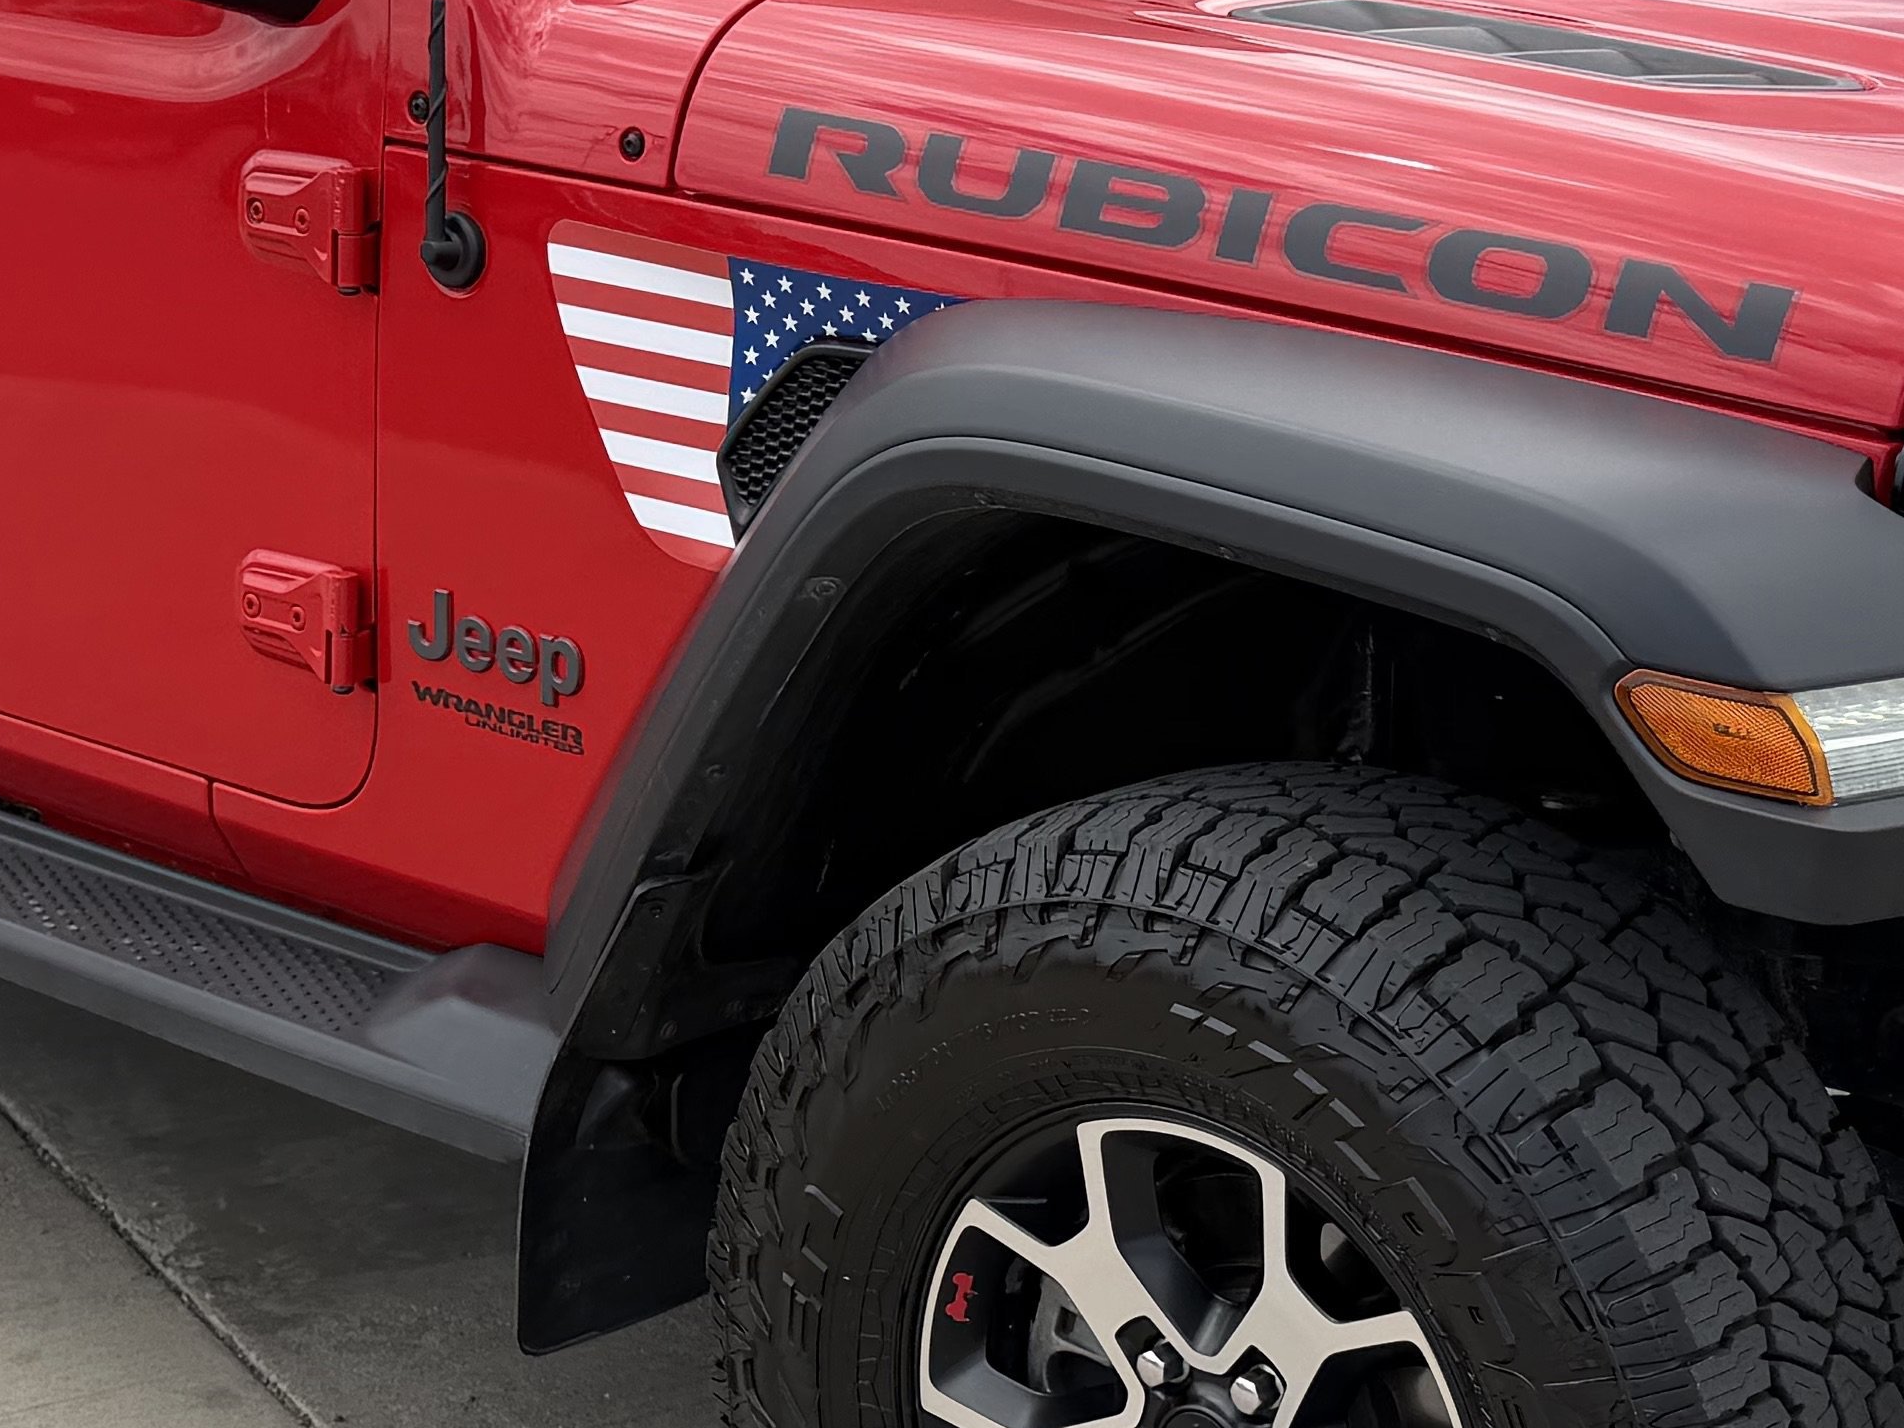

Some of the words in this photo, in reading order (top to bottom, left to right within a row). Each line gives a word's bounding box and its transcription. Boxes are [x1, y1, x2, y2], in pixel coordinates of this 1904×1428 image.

[764, 104, 1800, 367] RUBICON
[407, 588, 585, 708] Jeep
[411, 679, 583, 747] WRANGLER
[465, 713, 585, 756] UNLIMITED
